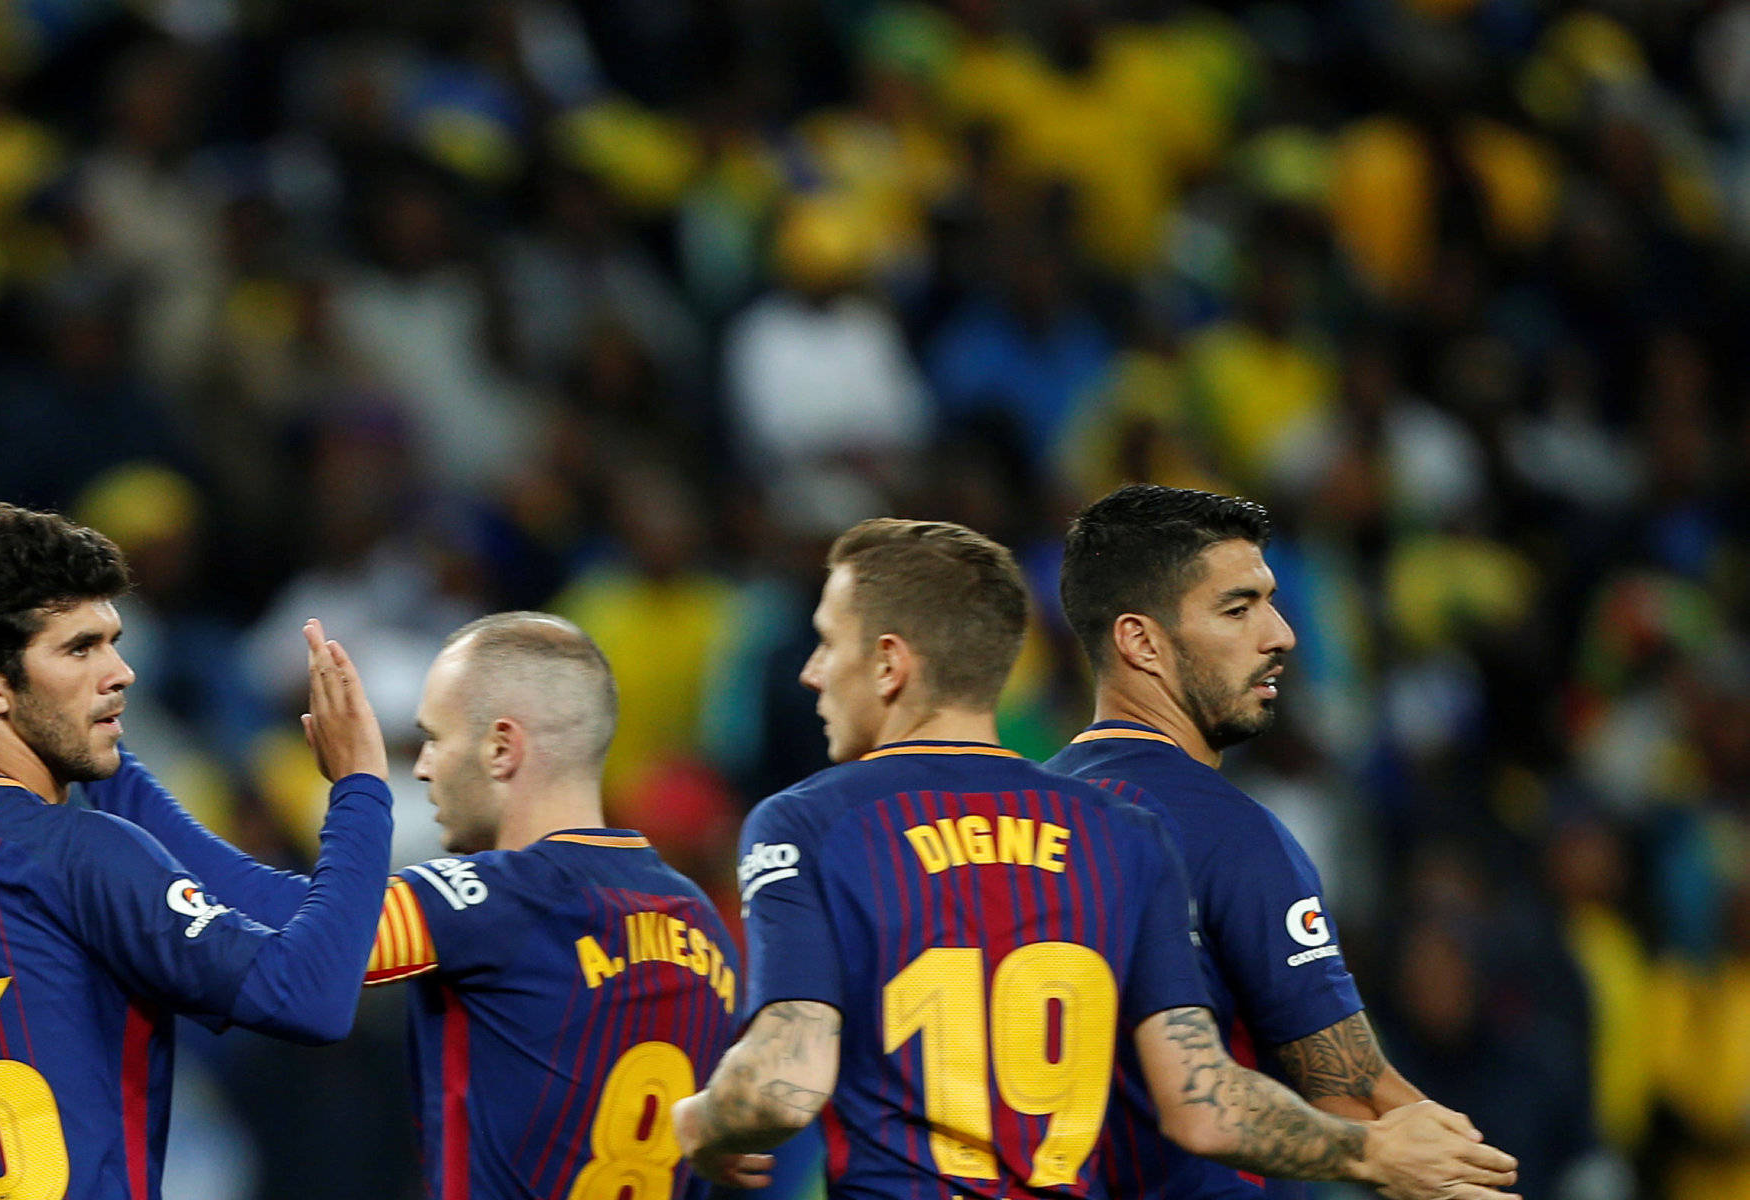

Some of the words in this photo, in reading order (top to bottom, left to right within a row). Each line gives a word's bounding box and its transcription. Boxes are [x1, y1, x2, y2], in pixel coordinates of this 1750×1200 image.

[736, 841, 801, 883] eko
[904, 814, 1072, 874] DIGNE
[424, 858, 489, 905] eko
[1285, 895, 1332, 948] G
[574, 934, 627, 990] A.
[882, 941, 1119, 1188] 19
